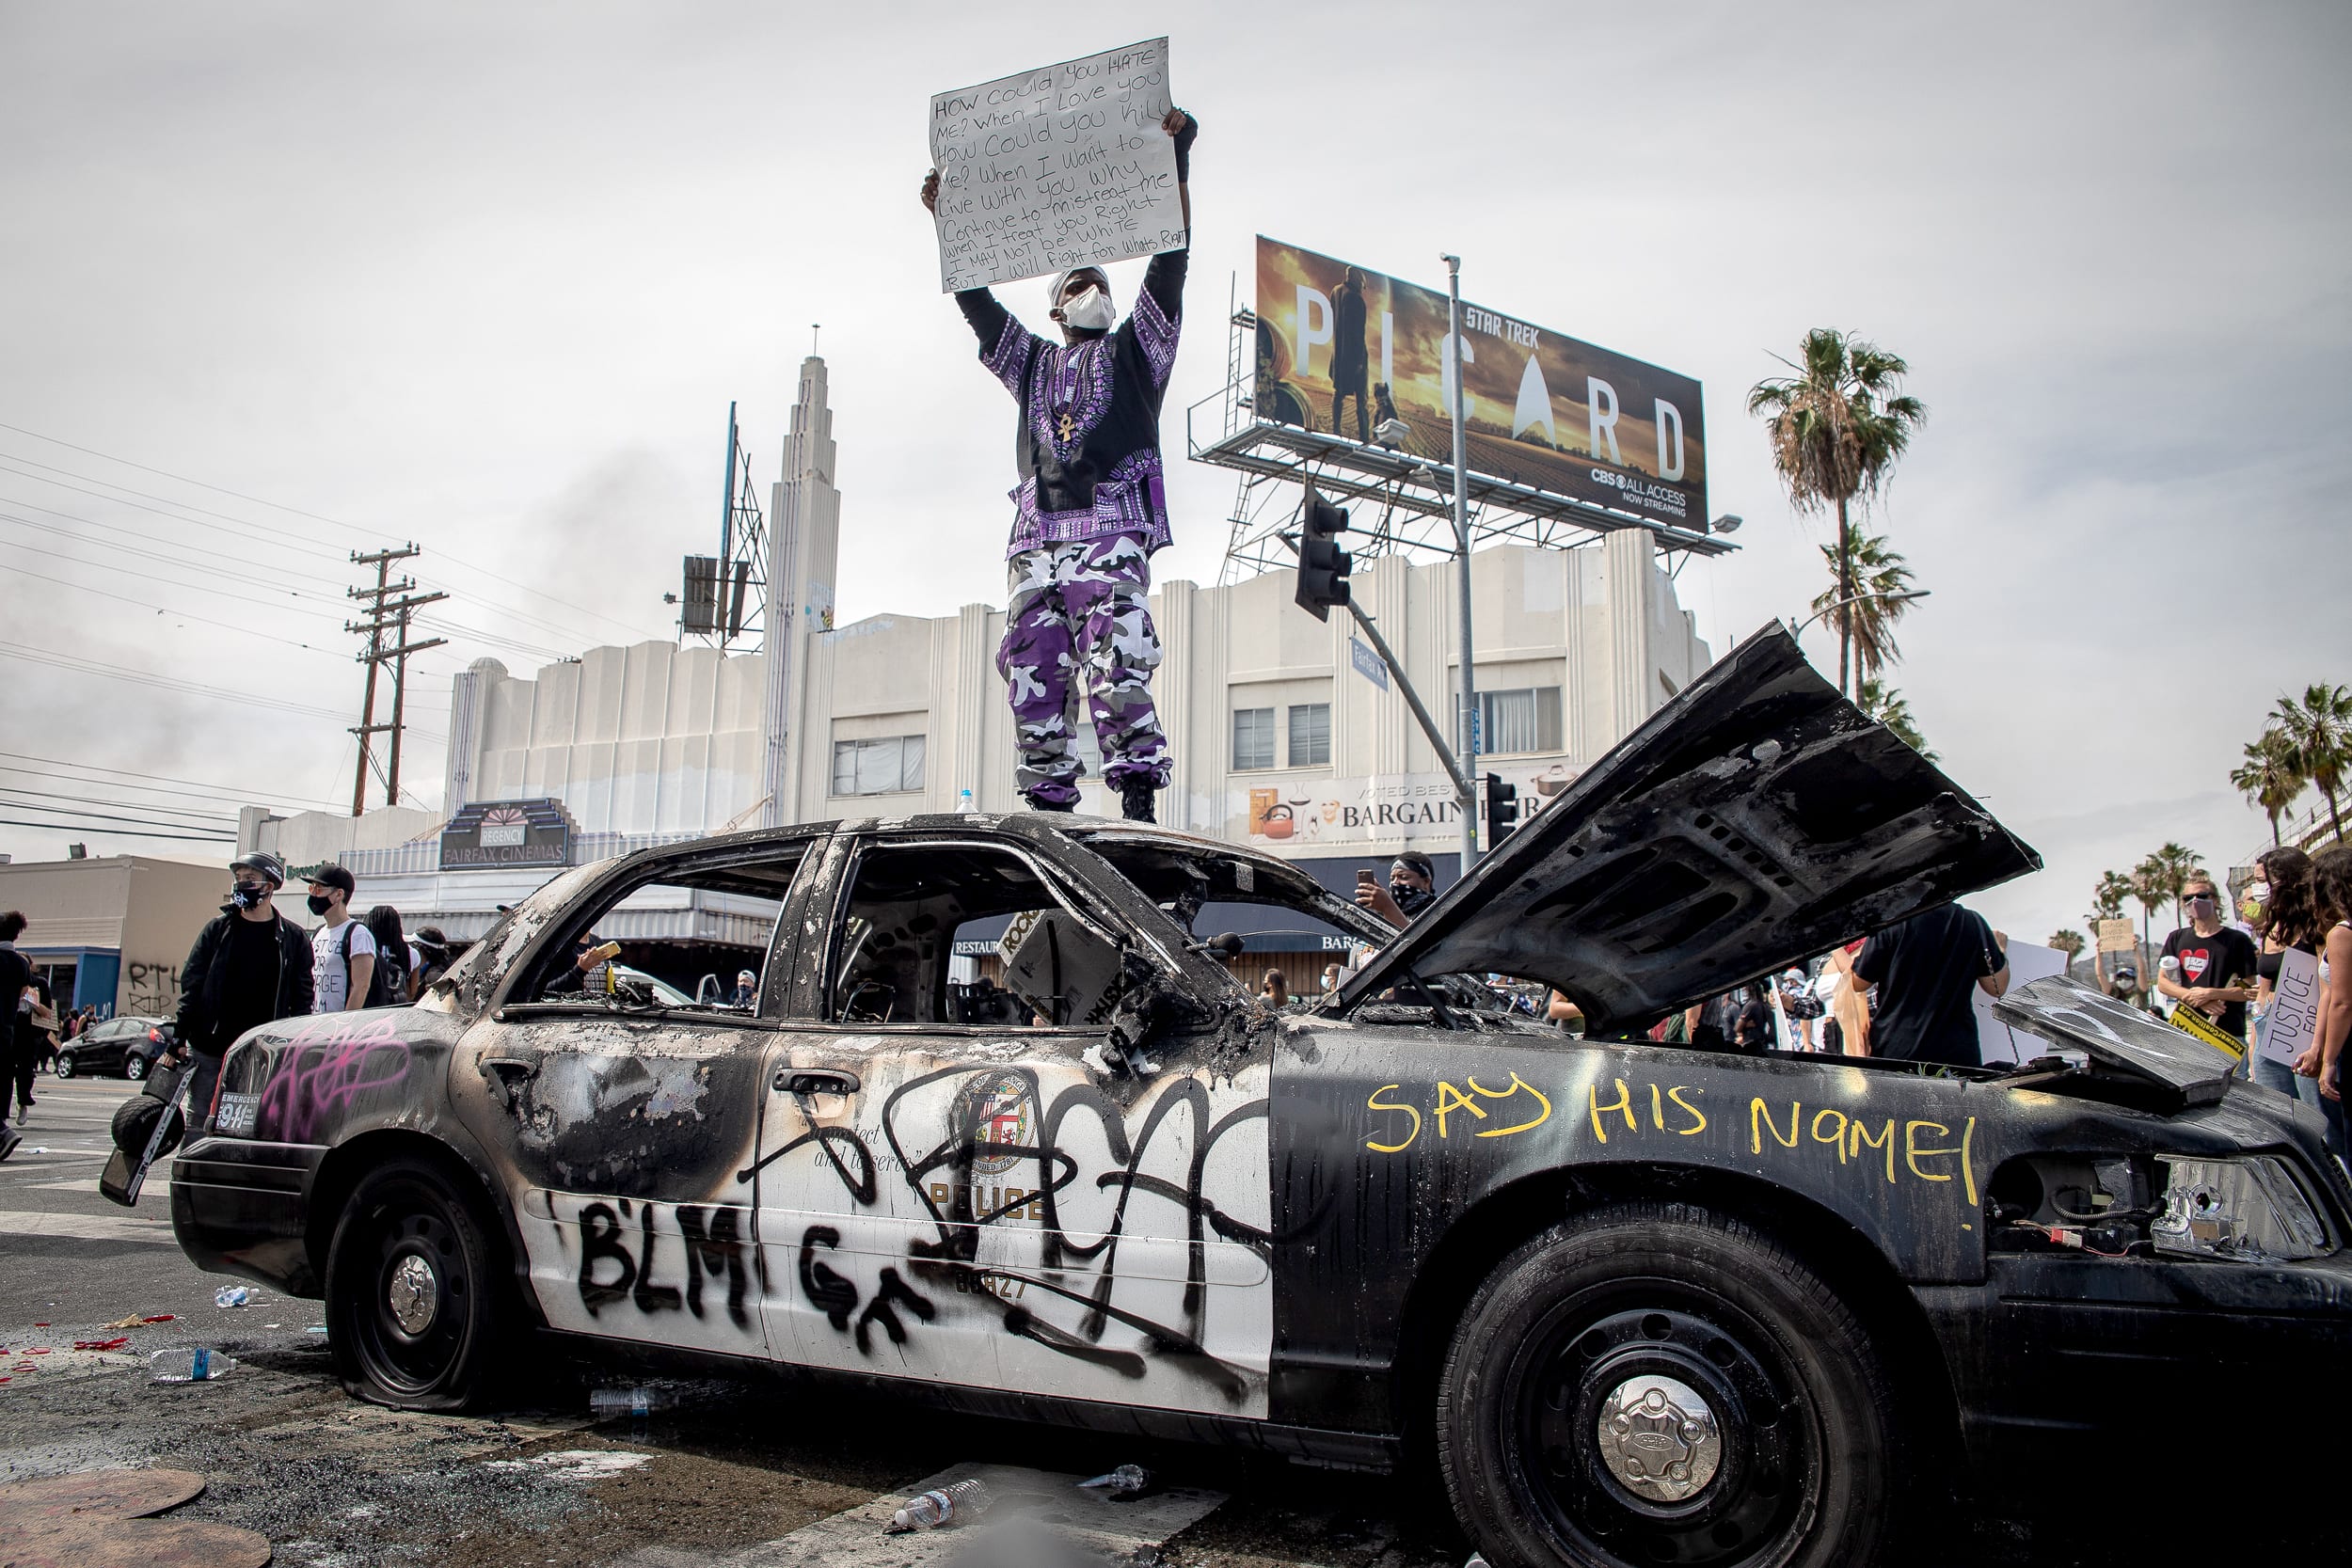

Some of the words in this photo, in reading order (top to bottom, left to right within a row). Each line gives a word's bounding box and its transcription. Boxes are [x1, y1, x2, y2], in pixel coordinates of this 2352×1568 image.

[935, 94, 979, 119] HOW
[1108, 49, 1156, 75] HATE
[1034, 96, 1051, 119] I
[1035, 155, 1057, 182] I
[1116, 134, 1145, 151] to
[1021, 207, 1041, 224] to
[1052, 182, 1132, 217] mistreat
[1139, 173, 1174, 192] me
[984, 233, 1000, 250] I
[1001, 221, 1045, 245] treat
[949, 259, 966, 276] I
[969, 249, 1001, 269] MAY
[1040, 237, 1069, 250] be
[987, 266, 1003, 284] I
[1091, 241, 1117, 261] for
[1466, 306, 1502, 339] STAR
[1505, 319, 1540, 351] TREK
[1591, 467, 1616, 487] CBS
[1626, 478, 1646, 496] ALL
[1646, 483, 1687, 508] ACCESS
[1623, 491, 1643, 505] NOW
[1644, 497, 1687, 518] STREAMING
[1343, 800, 1462, 828] BARGAIN
[443, 846, 498, 863] FAIRFAX
[501, 844, 564, 862] CINEMAS
[482, 828, 523, 845] REGENCY
[314, 939, 342, 954] STICE
[2268, 967, 2314, 1053] JUSTICE
[1366, 1070, 1551, 1153] SAY
[1589, 1077, 1707, 1145] HIS
[930, 1182, 1046, 1221] POLICE
[579, 1201, 750, 1333] BLM
